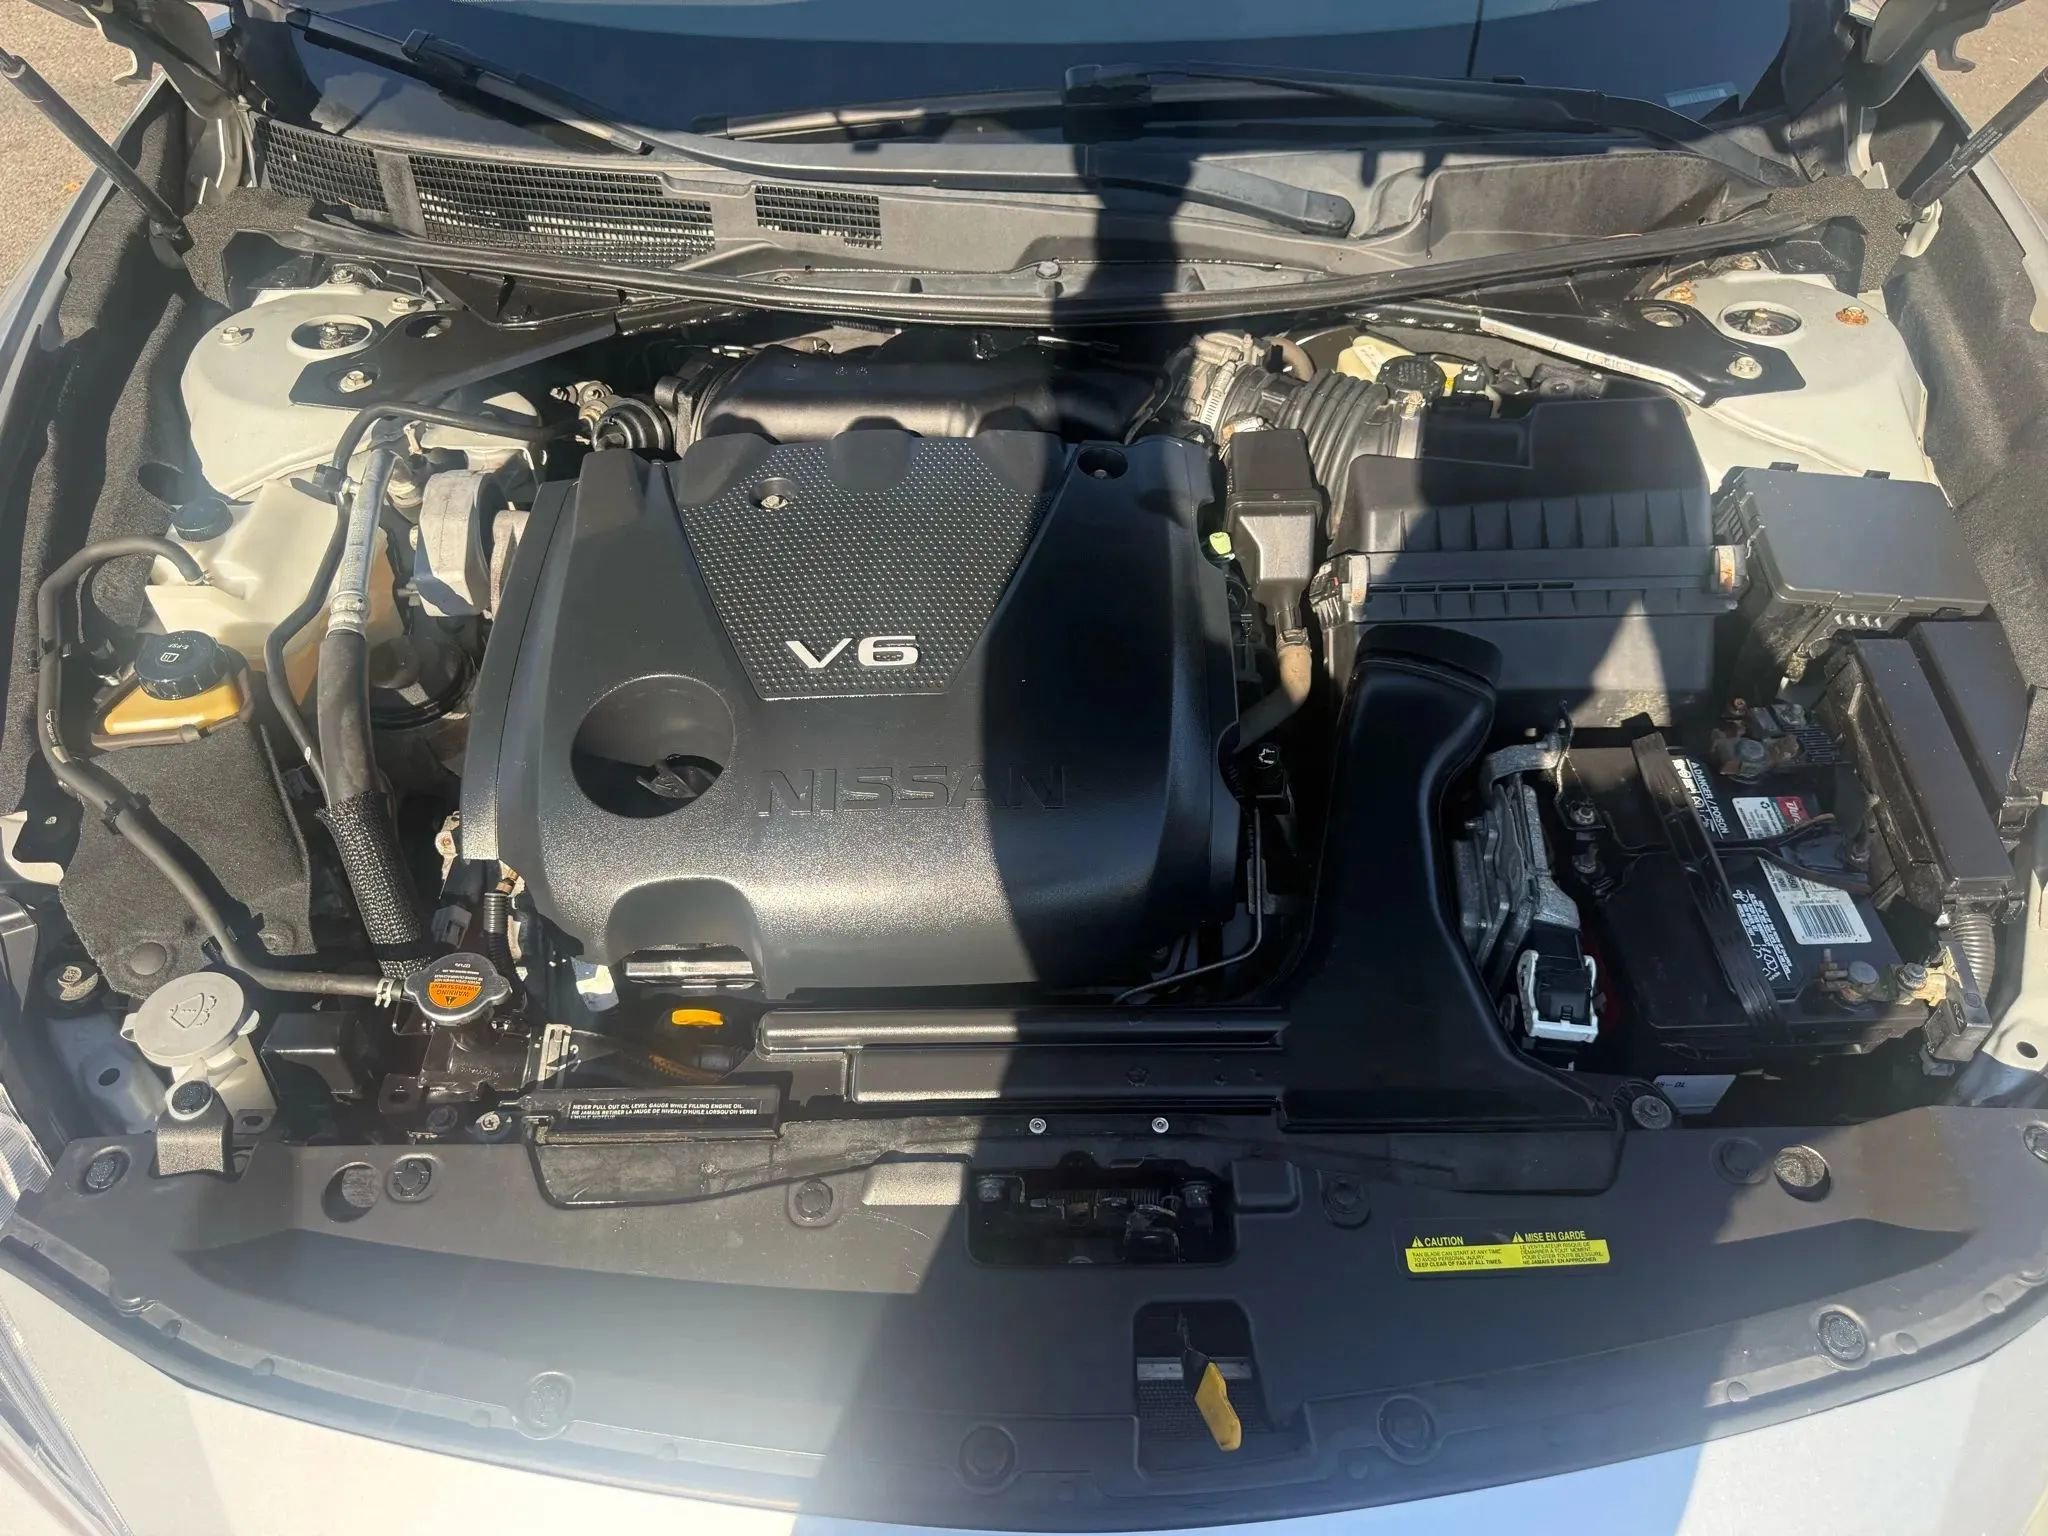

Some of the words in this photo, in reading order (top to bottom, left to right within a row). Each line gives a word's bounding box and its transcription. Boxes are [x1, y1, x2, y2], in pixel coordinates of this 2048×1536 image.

[785, 635, 919, 669] V6
[758, 764, 1065, 817] NISSAN
[1694, 769, 1714, 799] DANGER
[1710, 806, 1730, 833] POISON
[1425, 1236, 1464, 1247] CAUTION
[1525, 1232, 1541, 1241] MISE
[1545, 1232, 1557, 1241] EN
[1558, 1231, 1586, 1240] GARDE
